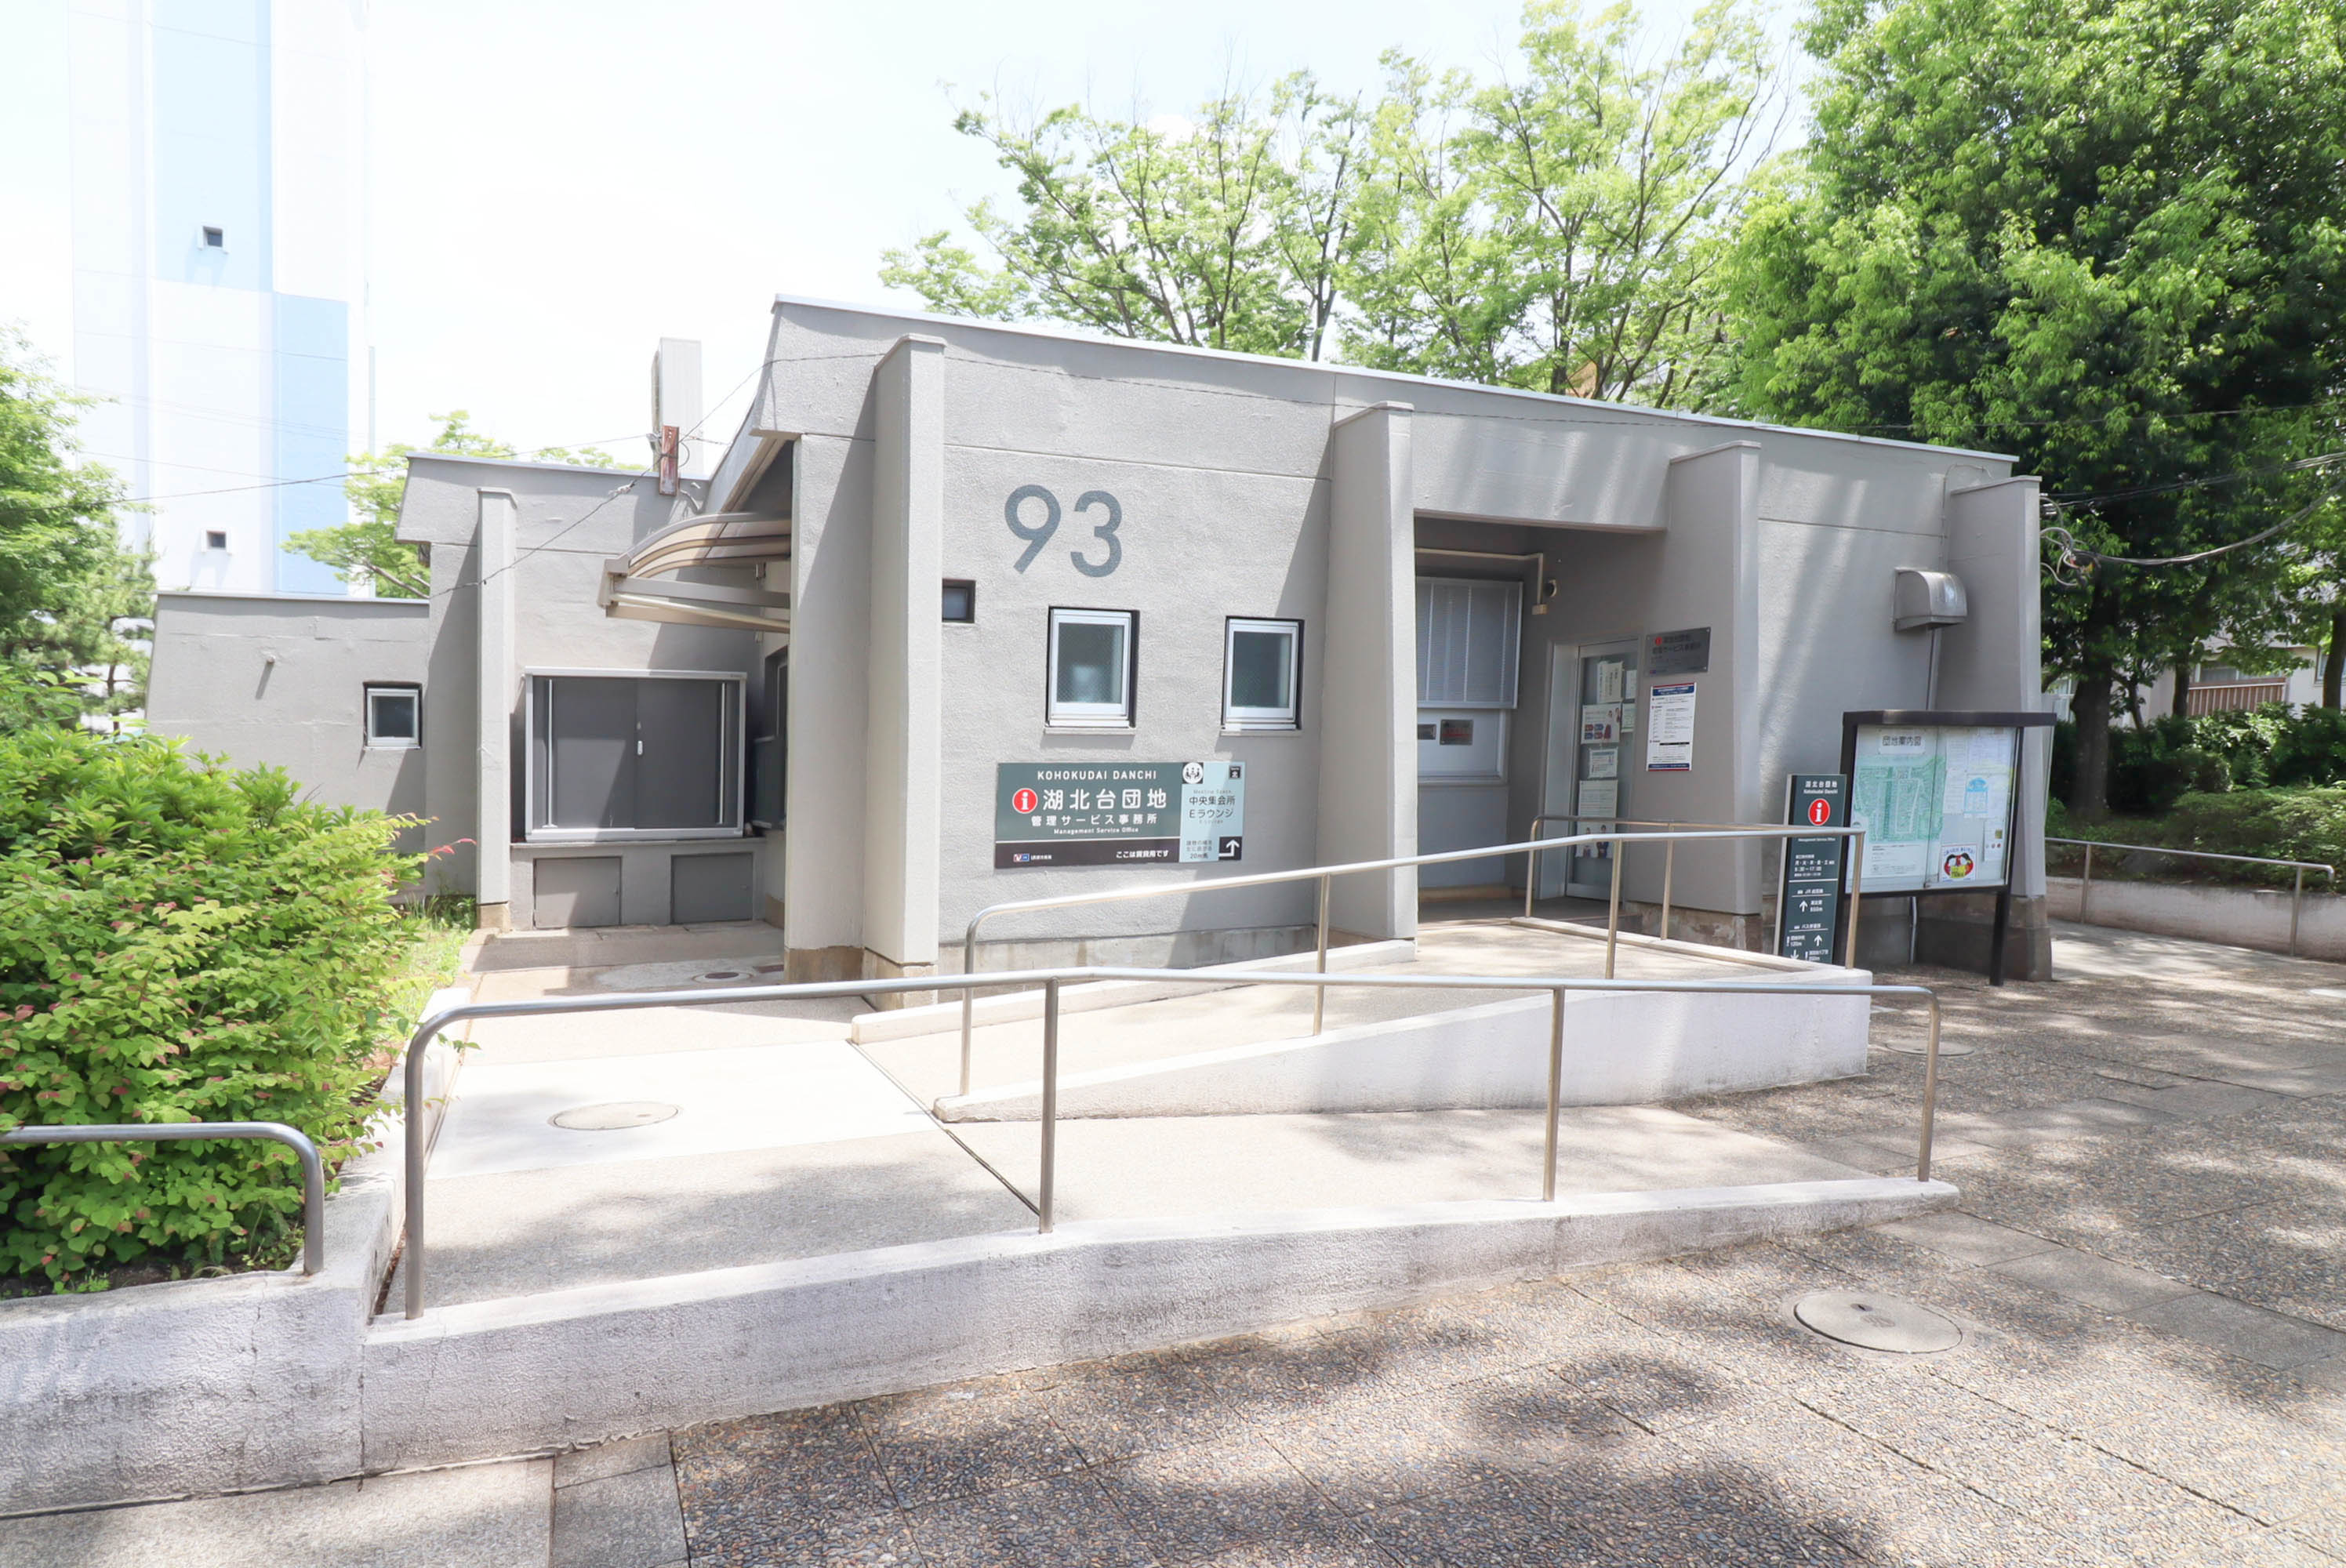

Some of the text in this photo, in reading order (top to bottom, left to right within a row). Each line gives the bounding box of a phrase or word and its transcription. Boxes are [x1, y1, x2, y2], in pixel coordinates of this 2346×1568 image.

[1004, 485, 1122, 578] 93
[1037, 770, 1157, 780] KOHOKUDAI DANCHI
[1043, 788, 1167, 811] 湖北台団地
[1189, 796, 1236, 806] 中央集会所
[1031, 813, 1157, 827] 管理サービス事務所
